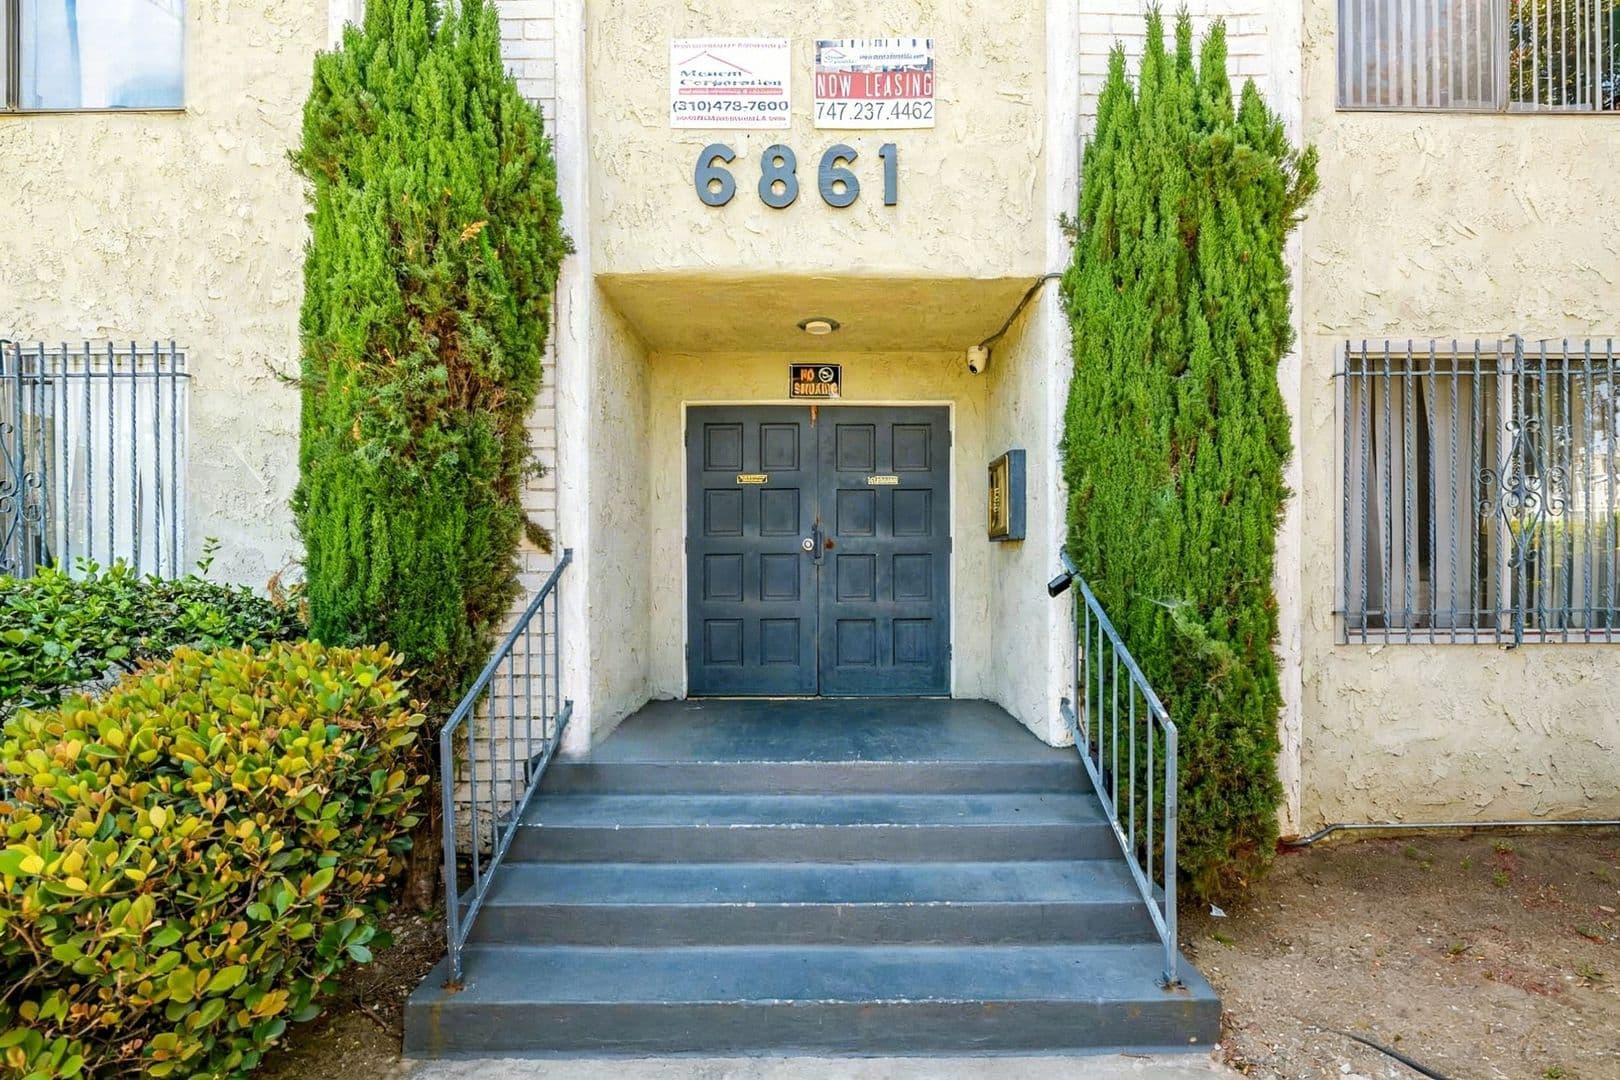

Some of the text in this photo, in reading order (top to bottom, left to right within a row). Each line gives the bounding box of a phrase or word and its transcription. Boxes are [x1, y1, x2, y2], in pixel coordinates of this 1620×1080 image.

[817, 73, 932, 97] NOW LEASING
[816, 101, 933, 120] 747.237.4462
[694, 143, 897, 208] 6861
